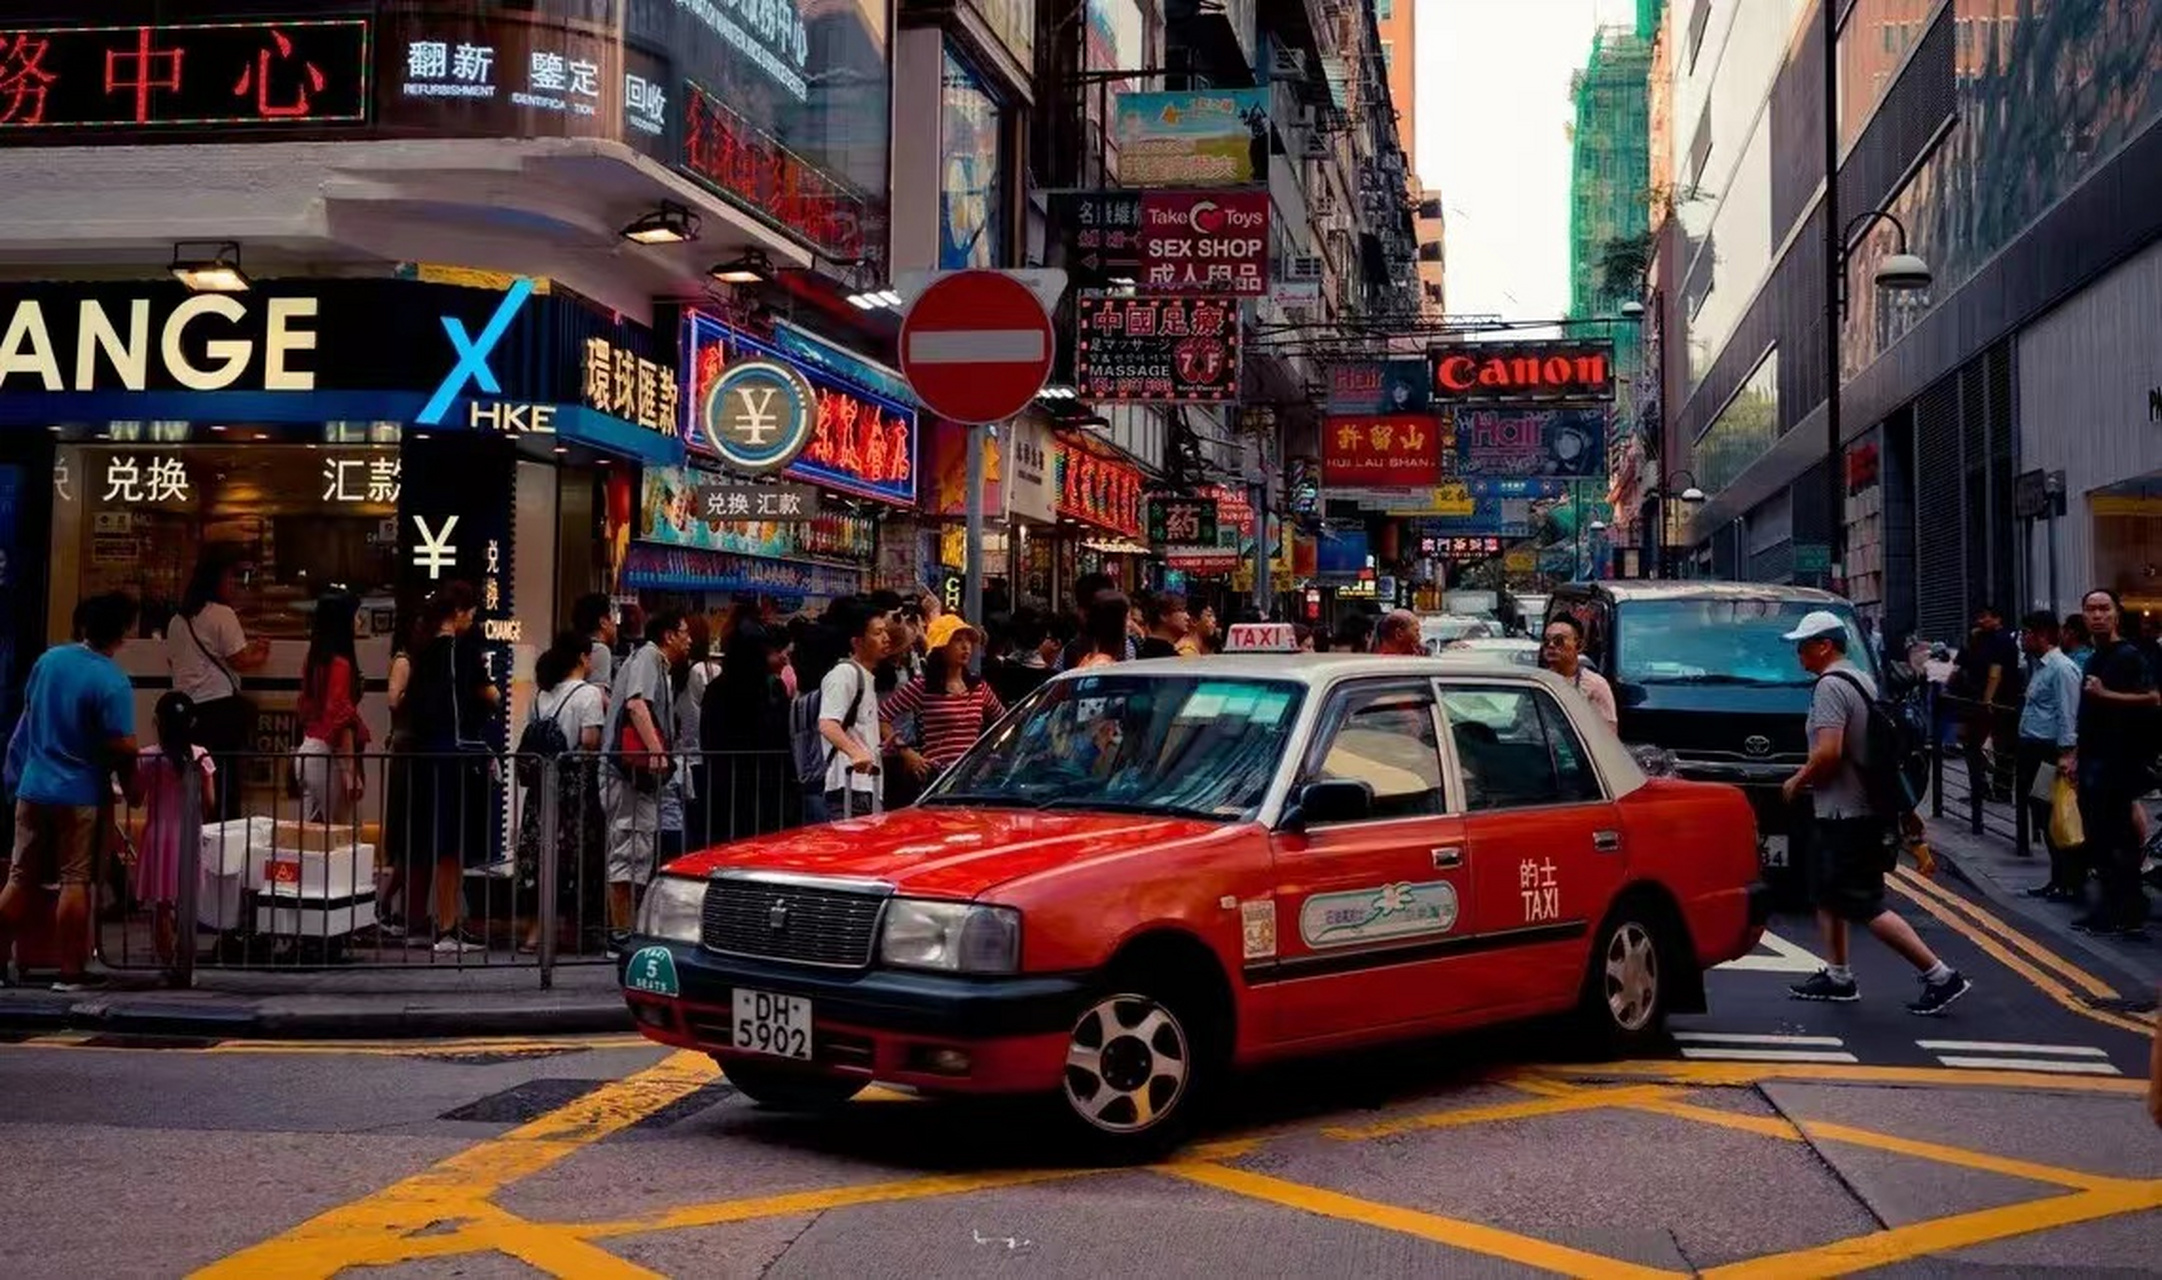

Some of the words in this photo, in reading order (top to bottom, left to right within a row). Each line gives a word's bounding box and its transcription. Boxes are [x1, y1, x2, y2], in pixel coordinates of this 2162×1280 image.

[407, 41, 494, 83] 翻新
[403, 83, 496, 99] REFURBISHMENT
[625, 74, 667, 125] 回收
[1149, 208, 1188, 225] Take
[1225, 208, 1263, 229] Toys
[1149, 239, 1193, 258] SEX
[1198, 239, 1262, 258] SHOP
[1150, 263, 1262, 291] 成人用品
[0, 294, 318, 391] ANGE
[1089, 365, 1171, 377] MASSAGE
[1437, 355, 1609, 390] Canon
[586, 337, 679, 437] 環球匯款
[470, 401, 557, 433] HKE
[1337, 424, 1425, 451] 許留山
[1327, 458, 1351, 468] HUI
[1355, 458, 1384, 468] LAU
[103, 457, 190, 502] 兑换
[322, 457, 401, 502] 汇款
[707, 493, 749, 515] 兑换
[757, 493, 801, 515] 汇款
[485, 619, 521, 640] CHANGE
[1231, 627, 1281, 647] TAXI
[1520, 857, 1557, 888] 的士
[1521, 889, 1559, 922] TAXI
[646, 960, 658, 978] 5
[755, 994, 790, 1026] DH
[738, 1019, 807, 1058] 5902
